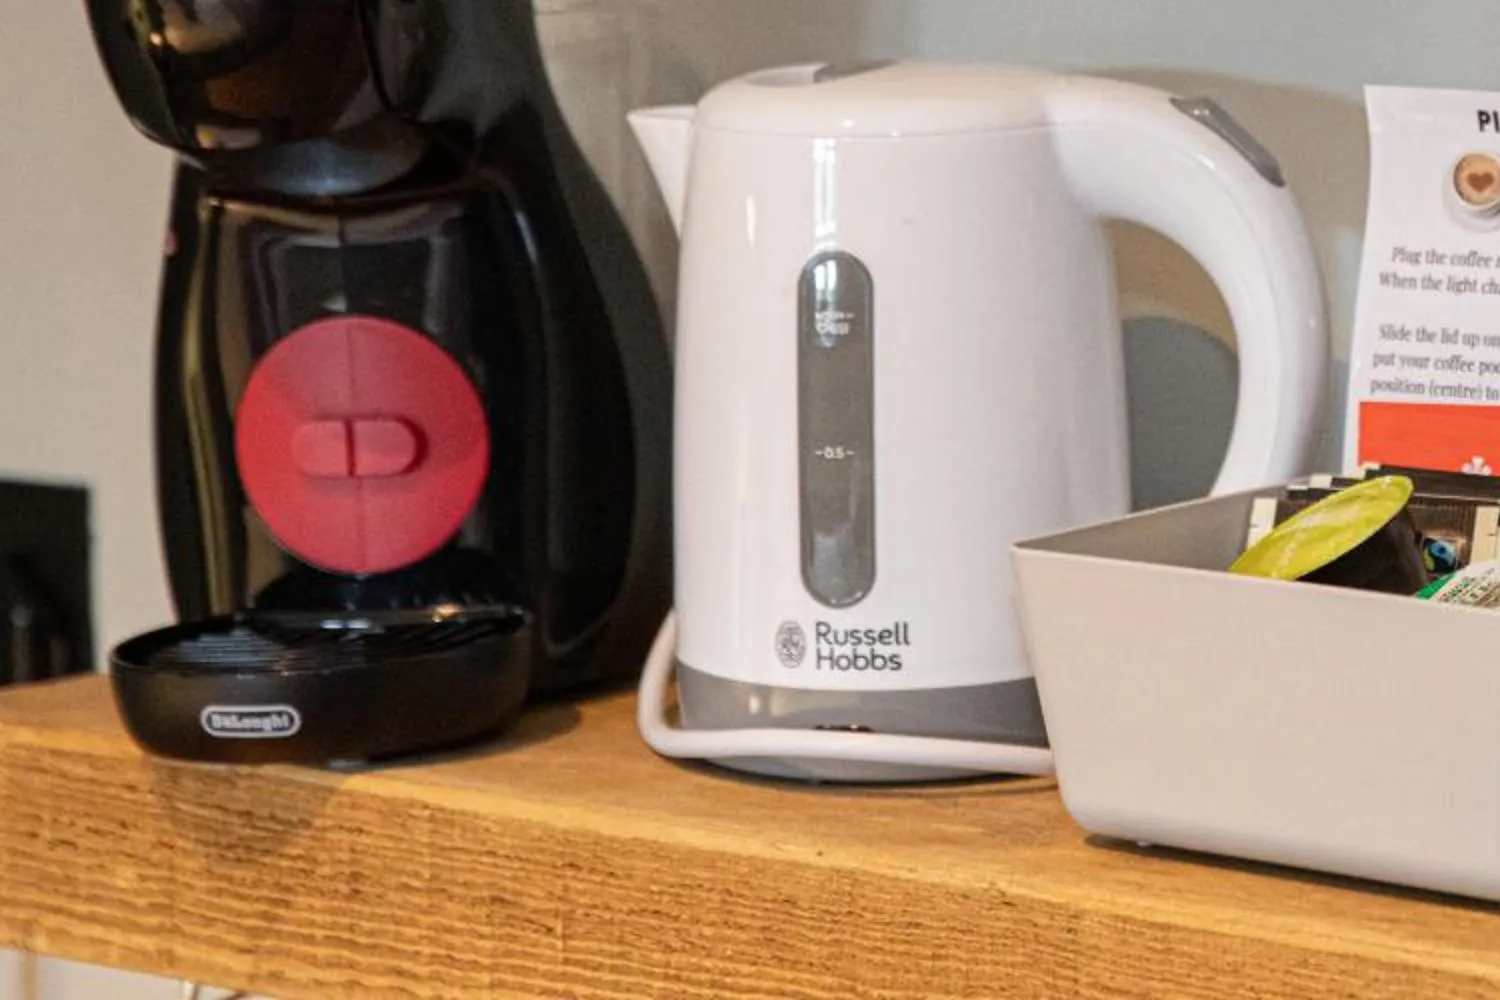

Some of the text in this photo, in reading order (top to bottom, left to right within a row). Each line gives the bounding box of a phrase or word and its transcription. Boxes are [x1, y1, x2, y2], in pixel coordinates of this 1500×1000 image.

[1391, 247, 1422, 266] Plug
[1425, 249, 1446, 265] the
[1450, 250, 1490, 268] coffee
[1379, 272, 1417, 289] When
[1421, 274, 1442, 291] the
[1446, 275, 1477, 294] light
[1379, 324, 1411, 342] Slide
[1416, 325, 1437, 342] the
[1441, 328, 1459, 344] lid
[1462, 332, 1480, 349] up
[1483, 334, 1500, 346] on
[1373, 352, 1395, 368] put
[1400, 355, 1430, 369] your
[1433, 355, 1474, 373] coffee
[1370, 378, 1425, 395] position
[1486, 385, 1499, 400] to
[816, 620, 910, 646] Russell
[816, 647, 903, 671] Hobbs
